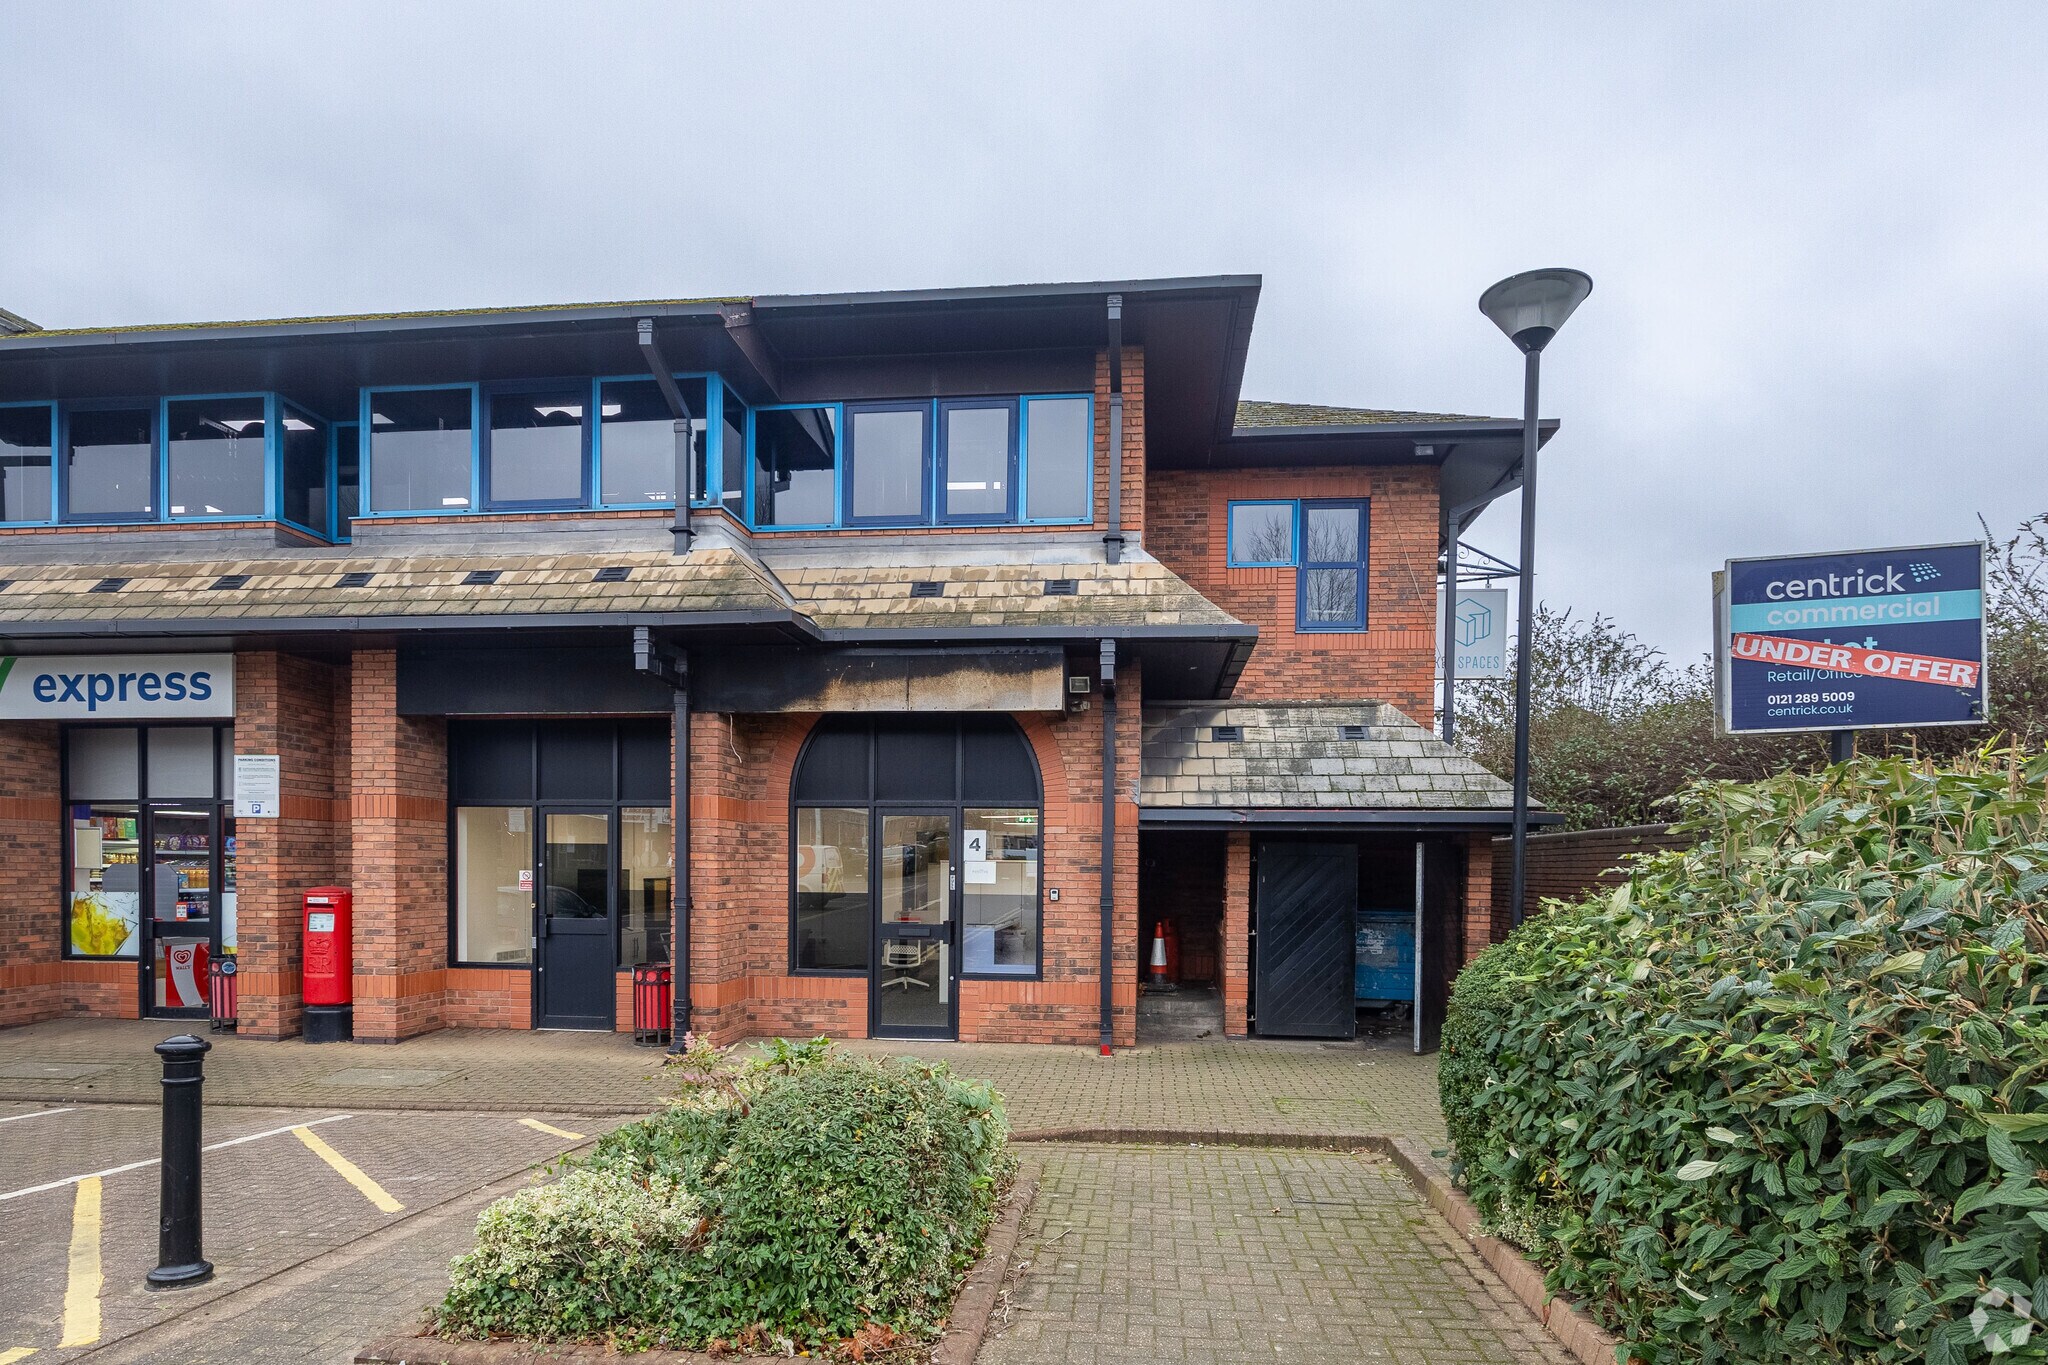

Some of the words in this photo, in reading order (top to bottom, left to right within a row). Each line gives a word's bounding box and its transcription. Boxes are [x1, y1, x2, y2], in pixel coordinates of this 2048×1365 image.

[1766, 566, 1905, 600] centrick
[1767, 596, 1940, 625] commercial
[1458, 656, 1500, 669] SPACES
[1736, 638, 1852, 669] UNDER
[1864, 654, 1973, 685] OFFER
[33, 671, 212, 711] express
[1767, 694, 1792, 705] 0121
[1795, 693, 1819, 703] 289
[1822, 691, 1855, 702] 5009
[1767, 703, 1853, 717] centrick.co.uk
[969, 838, 981, 851] 4
